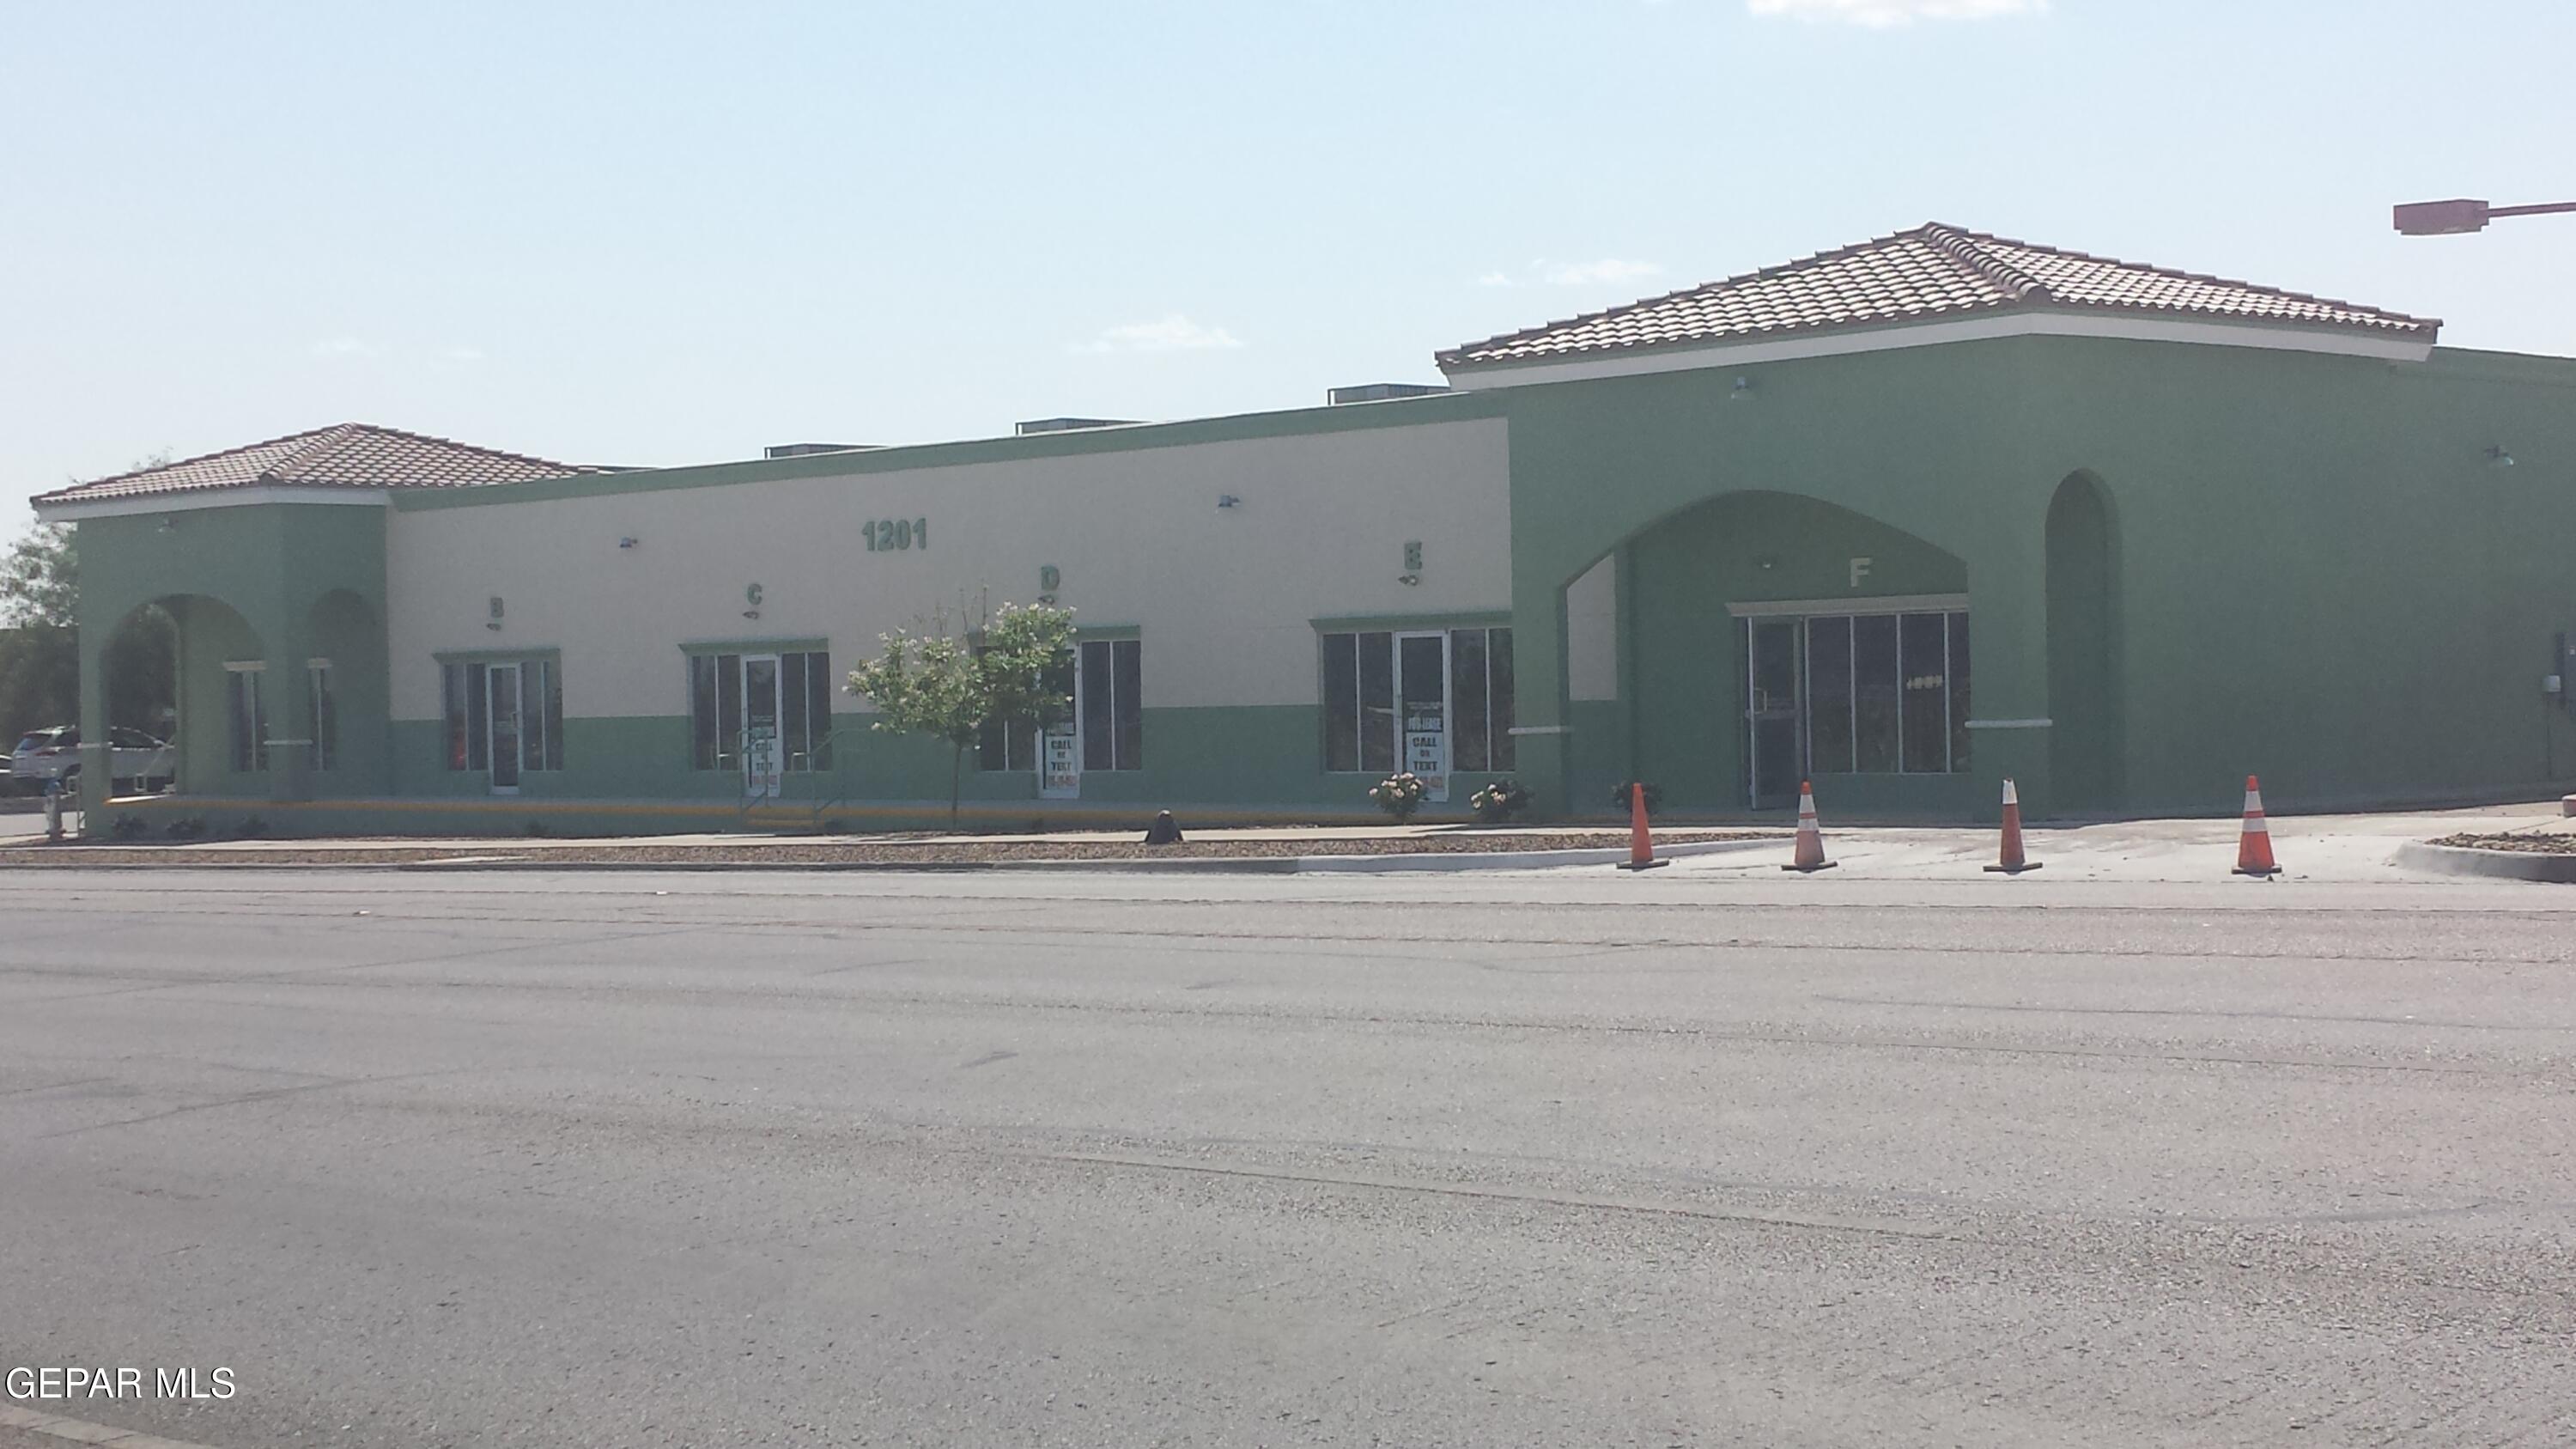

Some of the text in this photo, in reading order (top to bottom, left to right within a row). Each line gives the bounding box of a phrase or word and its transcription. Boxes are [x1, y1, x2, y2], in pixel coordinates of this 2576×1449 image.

[861, 517, 927, 551] 1201
[1404, 540, 1423, 569] E
[1041, 565, 1060, 591] D
[1850, 557, 1870, 588] F
[747, 583, 763, 606] C
[1050, 740, 1072, 750] CALL
[1413, 736, 1437, 747] CALL
[1050, 761, 1072, 771] TEXT
[1413, 761, 1438, 771] TEXT
